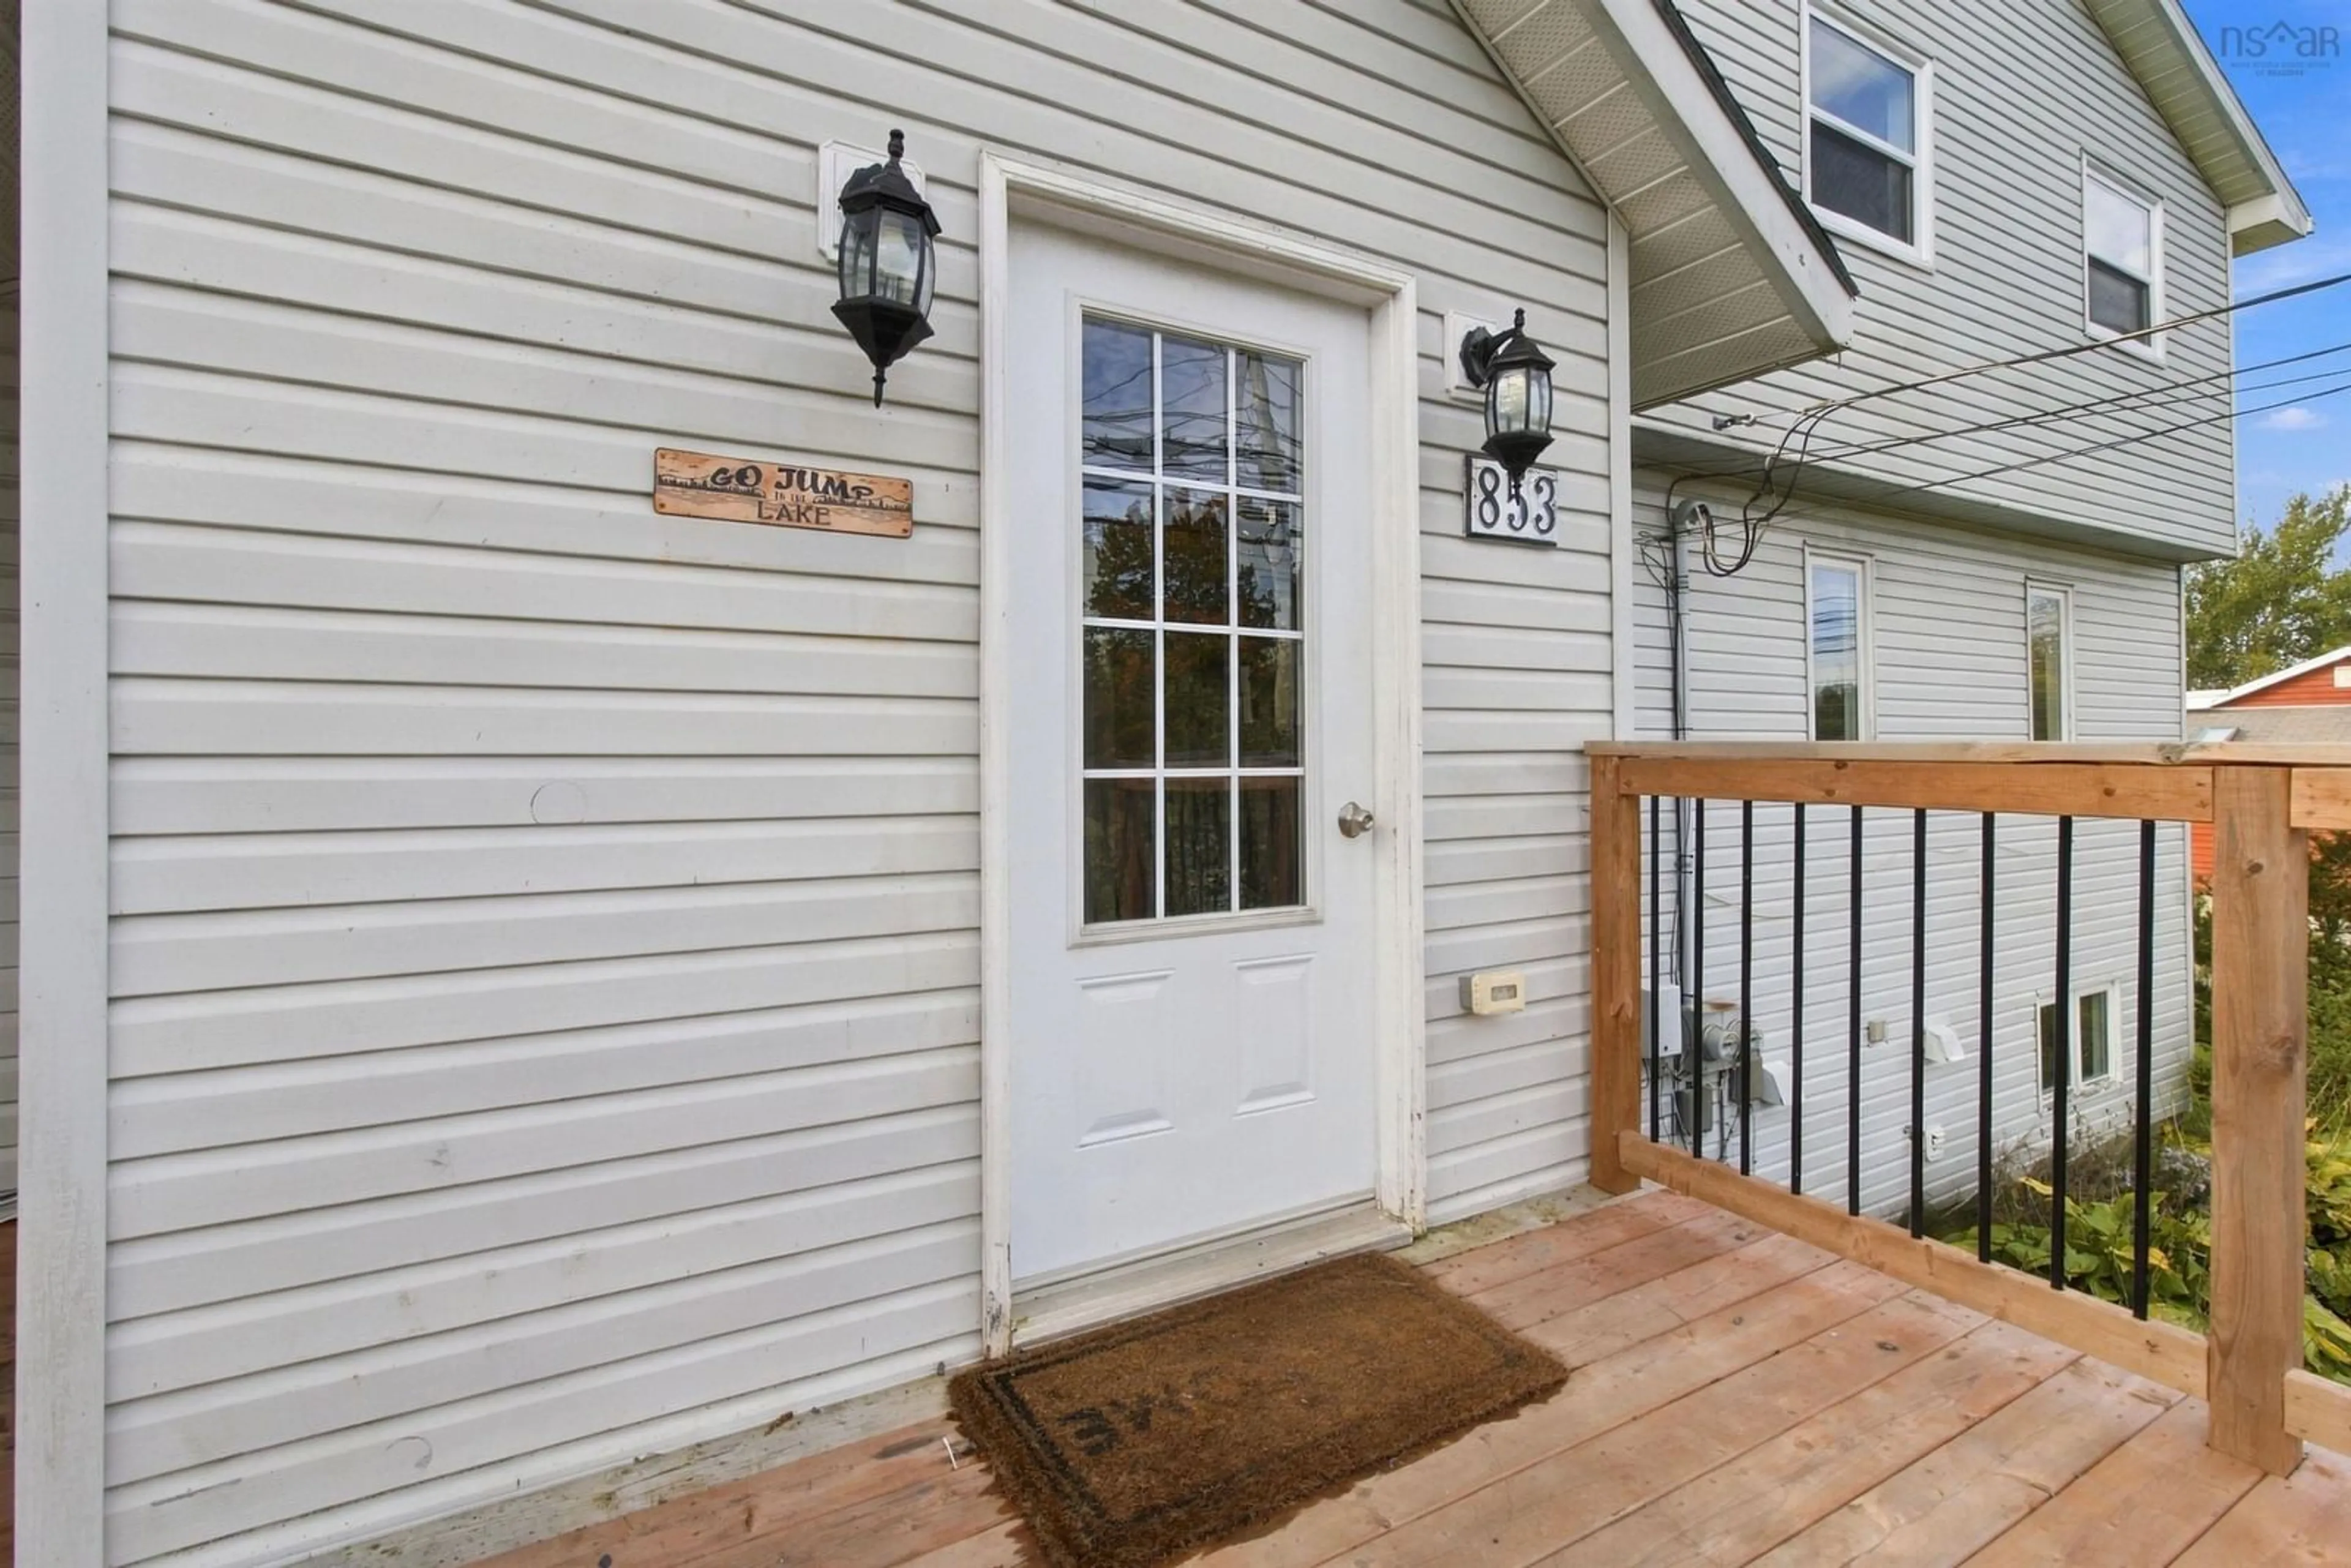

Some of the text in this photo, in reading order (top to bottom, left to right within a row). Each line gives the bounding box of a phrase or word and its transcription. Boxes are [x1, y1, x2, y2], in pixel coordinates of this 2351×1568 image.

[711, 465, 762, 486] GO
[774, 467, 874, 500] JUMP
[757, 501, 831, 525] LAKE
[1479, 467, 1555, 535] 853
